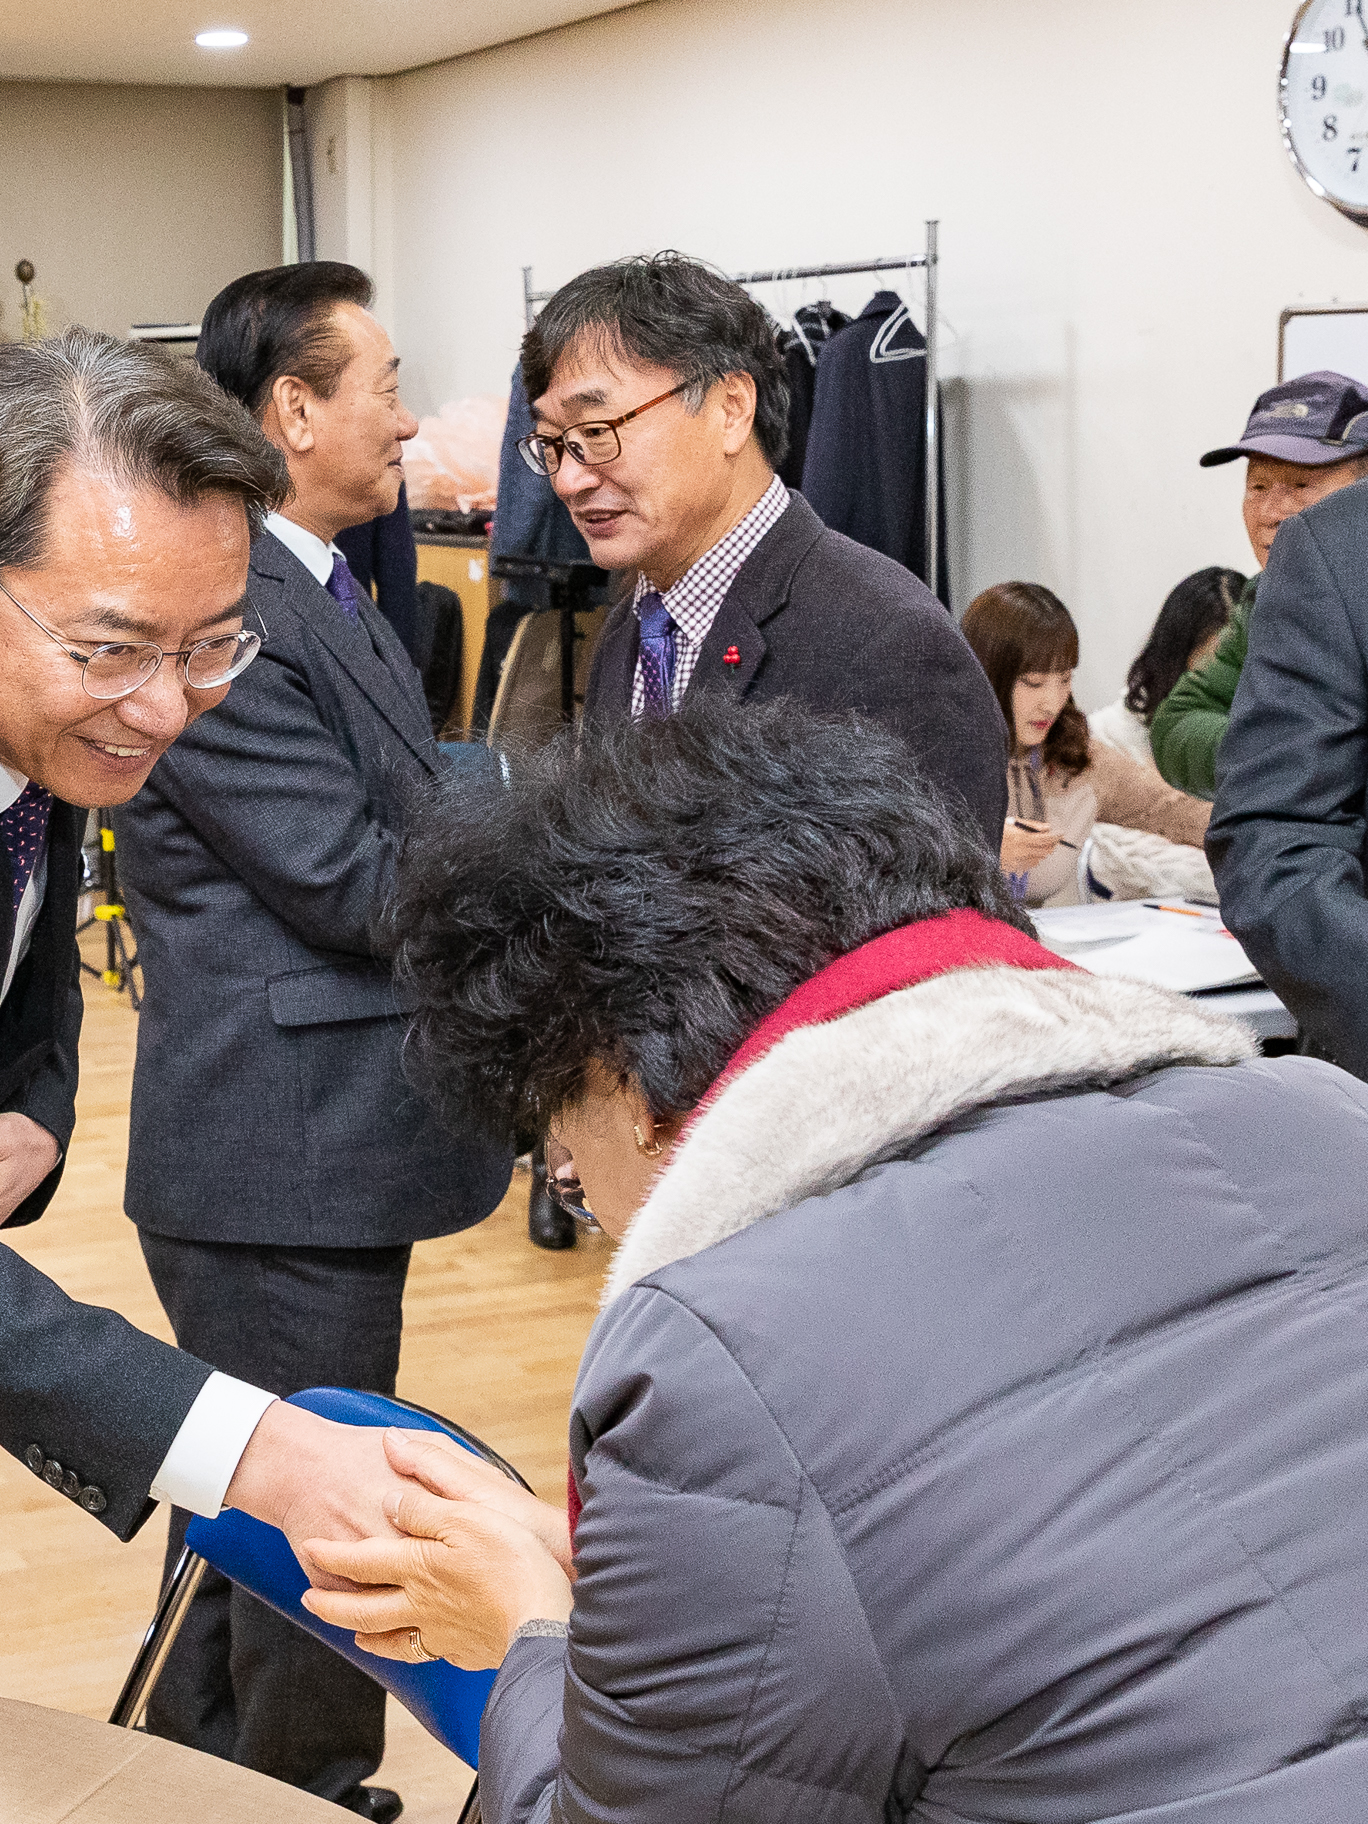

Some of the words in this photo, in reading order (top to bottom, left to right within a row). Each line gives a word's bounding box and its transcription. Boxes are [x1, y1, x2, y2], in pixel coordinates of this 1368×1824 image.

[1323, 26, 1345, 52] 10
[1312, 74, 1326, 100] 9
[1323, 115, 1338, 141] 8
[1346, 147, 1361, 173] 7
